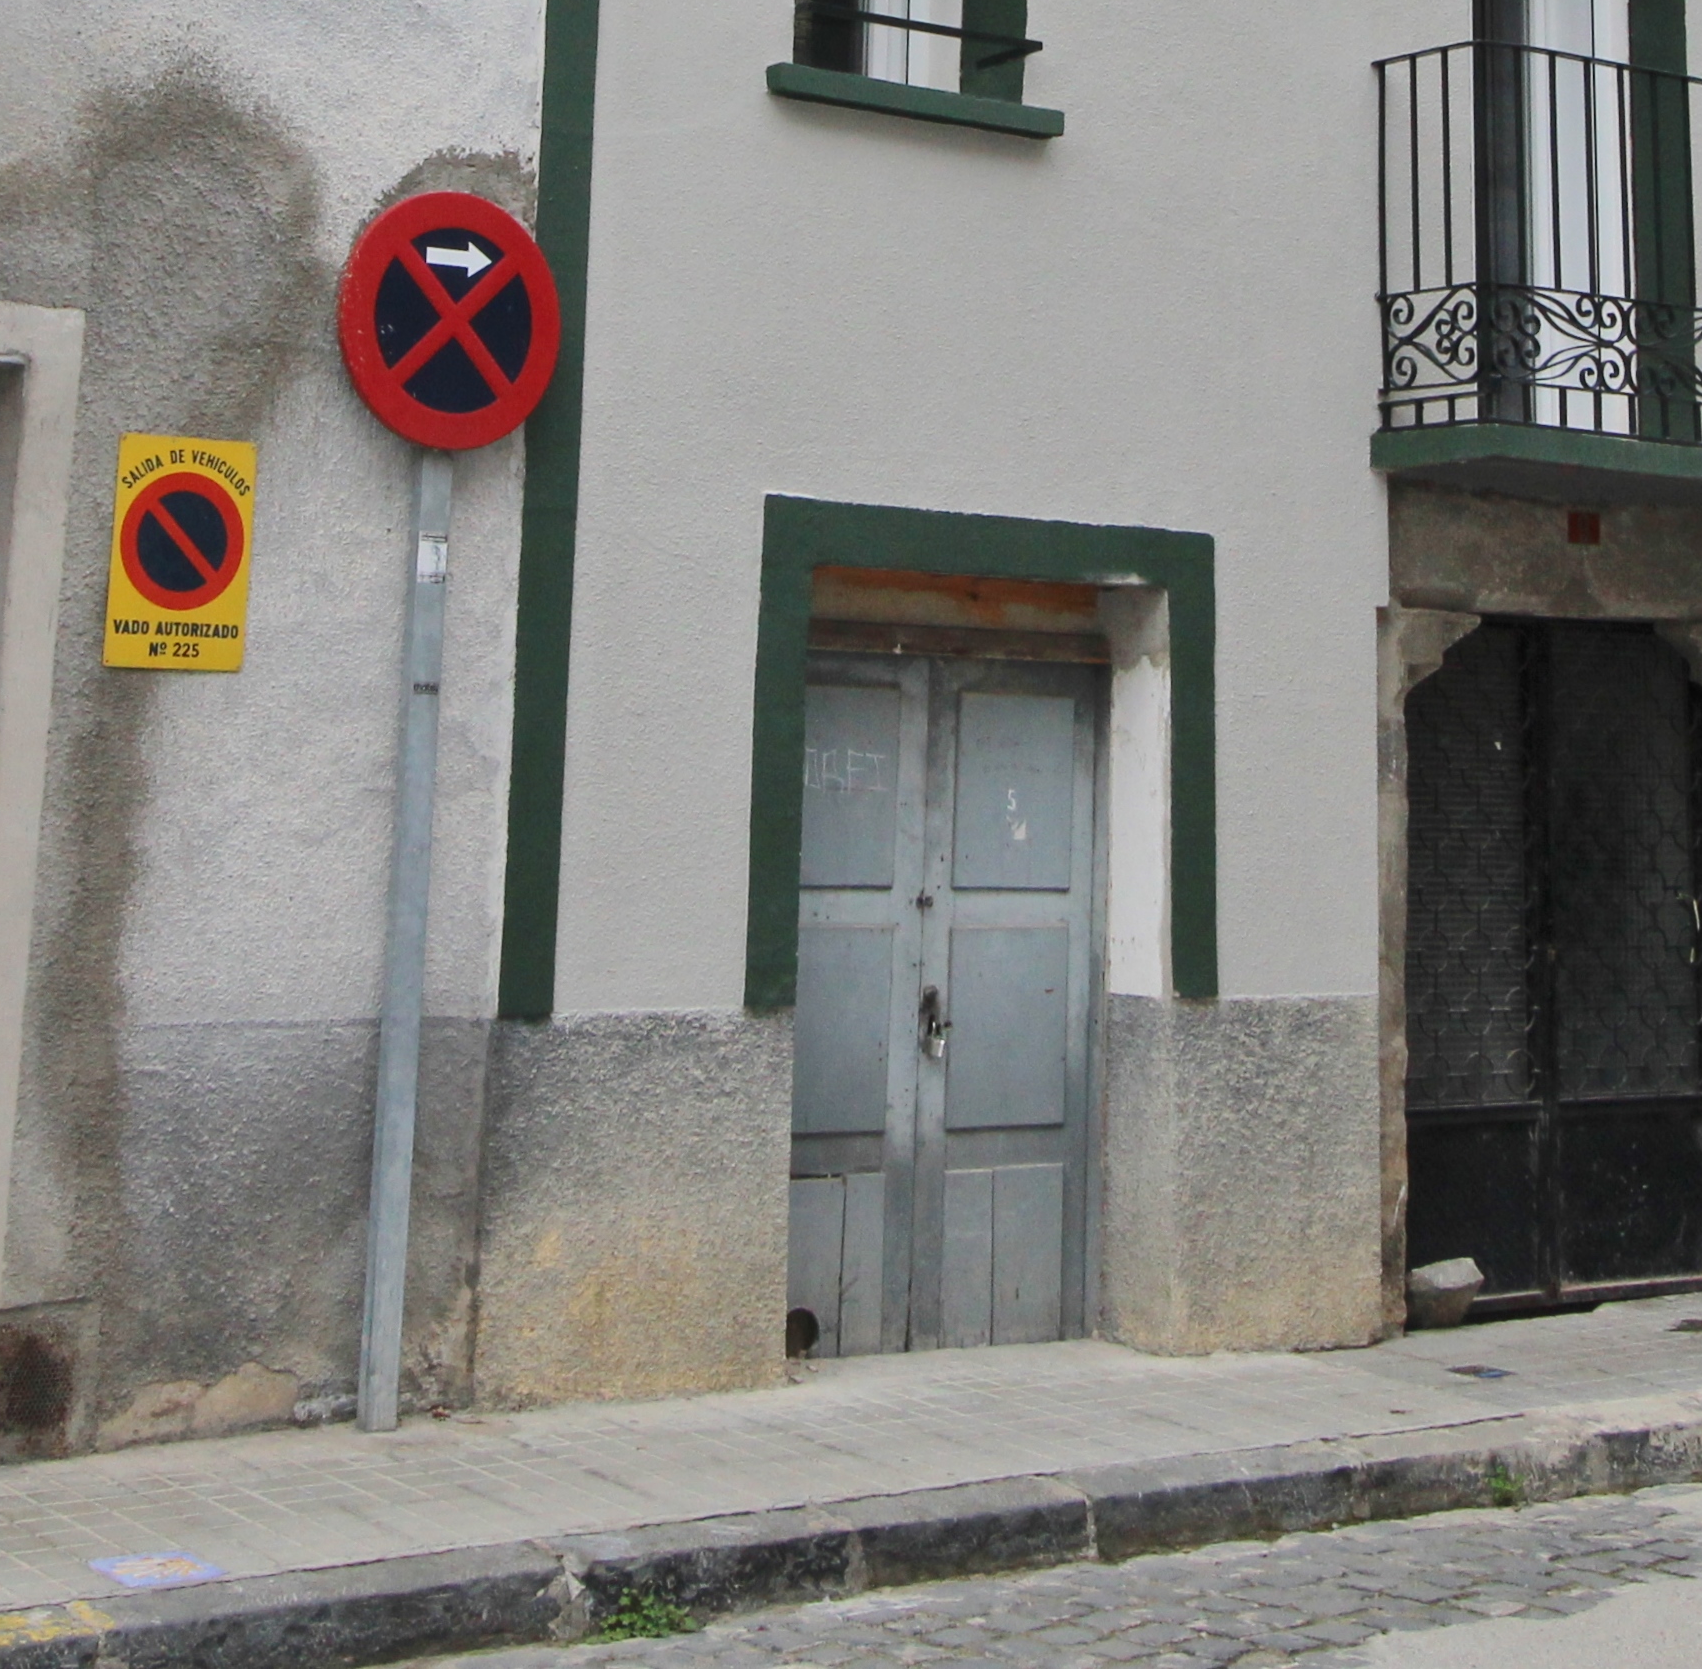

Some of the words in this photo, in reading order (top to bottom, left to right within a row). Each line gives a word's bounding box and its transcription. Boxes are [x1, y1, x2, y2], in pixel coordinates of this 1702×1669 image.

[121, 455, 164, 489] SALIDA
[170, 449, 186, 465] DE
[191, 450, 251, 497] VEHICULOS
[113, 619, 150, 635] VADO
[154, 621, 239, 639] AUTORIZADO
[172, 642, 200, 658] 225
